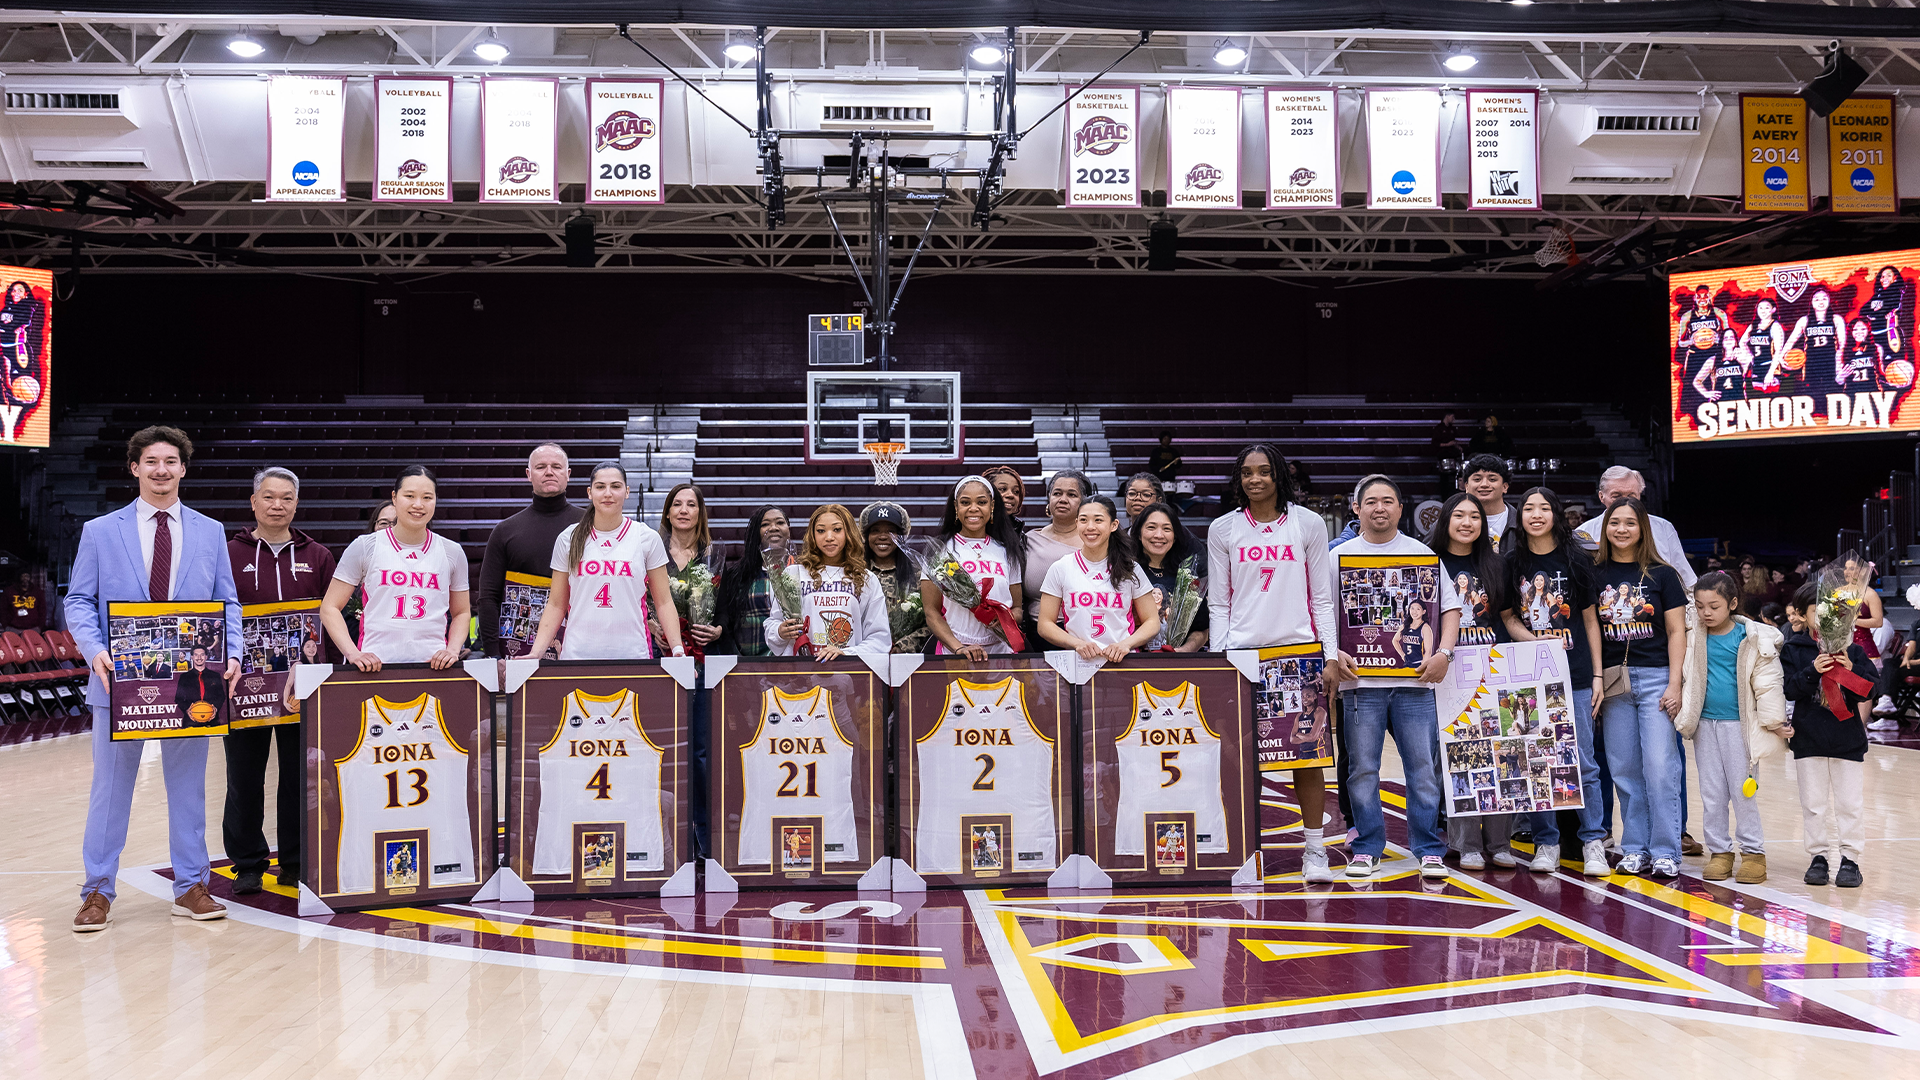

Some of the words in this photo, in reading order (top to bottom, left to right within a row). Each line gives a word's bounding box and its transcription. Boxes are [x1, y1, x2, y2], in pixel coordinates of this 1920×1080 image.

[294, 107, 320, 115] 2004
[401, 108, 426, 116] 2002
[296, 118, 318, 126] 2018
[400, 119, 426, 127] 2004
[1757, 114, 1793, 124] KATE
[1832, 116, 1889, 126] LEONARD
[402, 129, 425, 137] 2018
[597, 118, 655, 151] MAAC
[1290, 128, 1314, 136] 2023
[1752, 130, 1799, 140] AVERY
[1840, 132, 1883, 142] KORIR
[1075, 124, 1131, 156] MAAC
[1476, 140, 1498, 148] 2010
[1751, 147, 1800, 163] 2014
[1840, 149, 1884, 165] 2011
[398, 161, 428, 179] MAAC
[499, 162, 539, 184] MAAC
[600, 163, 651, 180] 2018
[1076, 168, 1130, 184] 2023
[294, 172, 320, 181] NCAA
[1185, 169, 1223, 190] MAAC
[1289, 170, 1317, 186] MAAC
[1766, 178, 1788, 186] NCAA
[1393, 181, 1416, 189] NCAA
[1852, 179, 1875, 187] NCAA
[381, 187, 445, 196] CHAMPIONS
[488, 188, 551, 197] CHAMPIONS
[594, 189, 657, 197] CHAMPIONS
[1073, 193, 1134, 201] CHAMPIONS
[1175, 194, 1234, 203] CHAMPIONS
[1274, 195, 1333, 203] CHAMPIONS
[1773, 271, 1811, 284] IONA
[382, 305, 389, 316] 8
[861, 307, 868, 318] 9
[1320, 308, 1333, 319] 10
[821, 317, 831, 331] 4
[847, 316, 862, 331] 19
[1807, 326, 1833, 336] IONA
[1751, 337, 1769, 345] ONA
[1813, 336, 1828, 347] 13
[1754, 346, 1762, 357] 5
[1717, 366, 1741, 376] ONA
[1852, 369, 1869, 381] 21
[1722, 378, 1733, 389] 4
[1697, 394, 1817, 440] SENIOR
[1825, 391, 1898, 429] DAY
[877, 507, 889, 518] NY
[1237, 544, 1297, 563] IONA
[578, 560, 634, 578] IONA
[962, 560, 1006, 577] ONA
[378, 569, 441, 591] IONA
[1260, 567, 1276, 592] 7
[594, 582, 613, 608] 4
[1069, 592, 1125, 610] IONA
[391, 594, 428, 620] 13
[813, 596, 851, 607] VARSITY
[1533, 609, 1540, 621] 5
[1616, 609, 1623, 618] 5
[1090, 613, 1107, 639] 5
[1603, 622, 1655, 642] FAJARDO
[813, 632, 826, 644] 95
[1456, 627, 1496, 646] ARDO
[1356, 644, 1384, 654] ELLA
[1406, 645, 1413, 655] 5
[1353, 657, 1396, 667] AJARDO
[1454, 643, 1559, 689] ELLA
[233, 692, 279, 706] YANNIE
[121, 703, 178, 716] MATHEW
[241, 706, 273, 718] CHAN
[117, 717, 183, 731] MOUNTAIN
[954, 728, 1015, 746] IONA
[1139, 727, 1200, 747] IONA
[568, 739, 630, 757] IONA
[768, 737, 829, 755] IONA
[1258, 739, 1283, 749] AOMI
[372, 742, 437, 765] IONA
[1258, 750, 1297, 762] NWELL
[972, 753, 996, 791] 2
[1160, 750, 1183, 788] 5
[584, 762, 613, 800] 4
[776, 760, 821, 798] 21
[383, 767, 430, 810] 13
